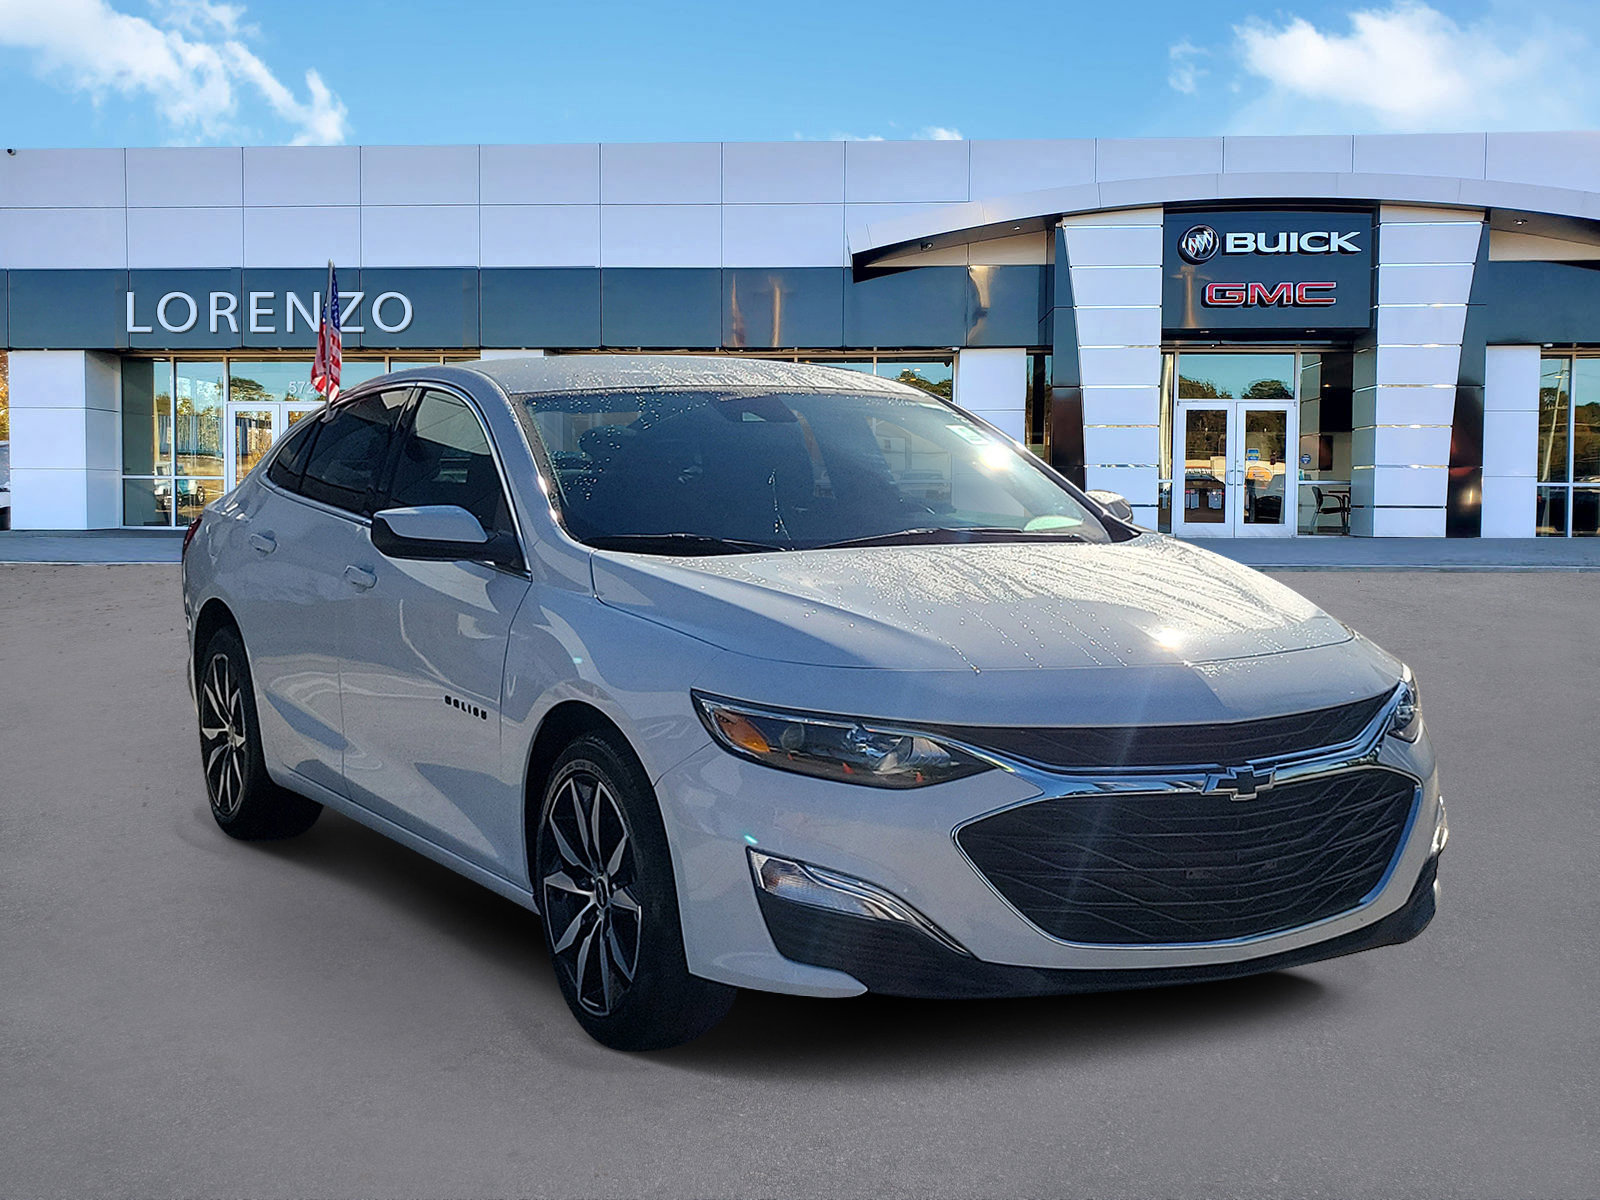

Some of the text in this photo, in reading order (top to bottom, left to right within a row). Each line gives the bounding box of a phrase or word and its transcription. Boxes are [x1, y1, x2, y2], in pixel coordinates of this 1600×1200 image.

[1225, 231, 1362, 253] BUICK
[1205, 282, 1337, 305] GMC
[126, 291, 413, 333] LORENZO
[288, 380, 320, 394] 572
